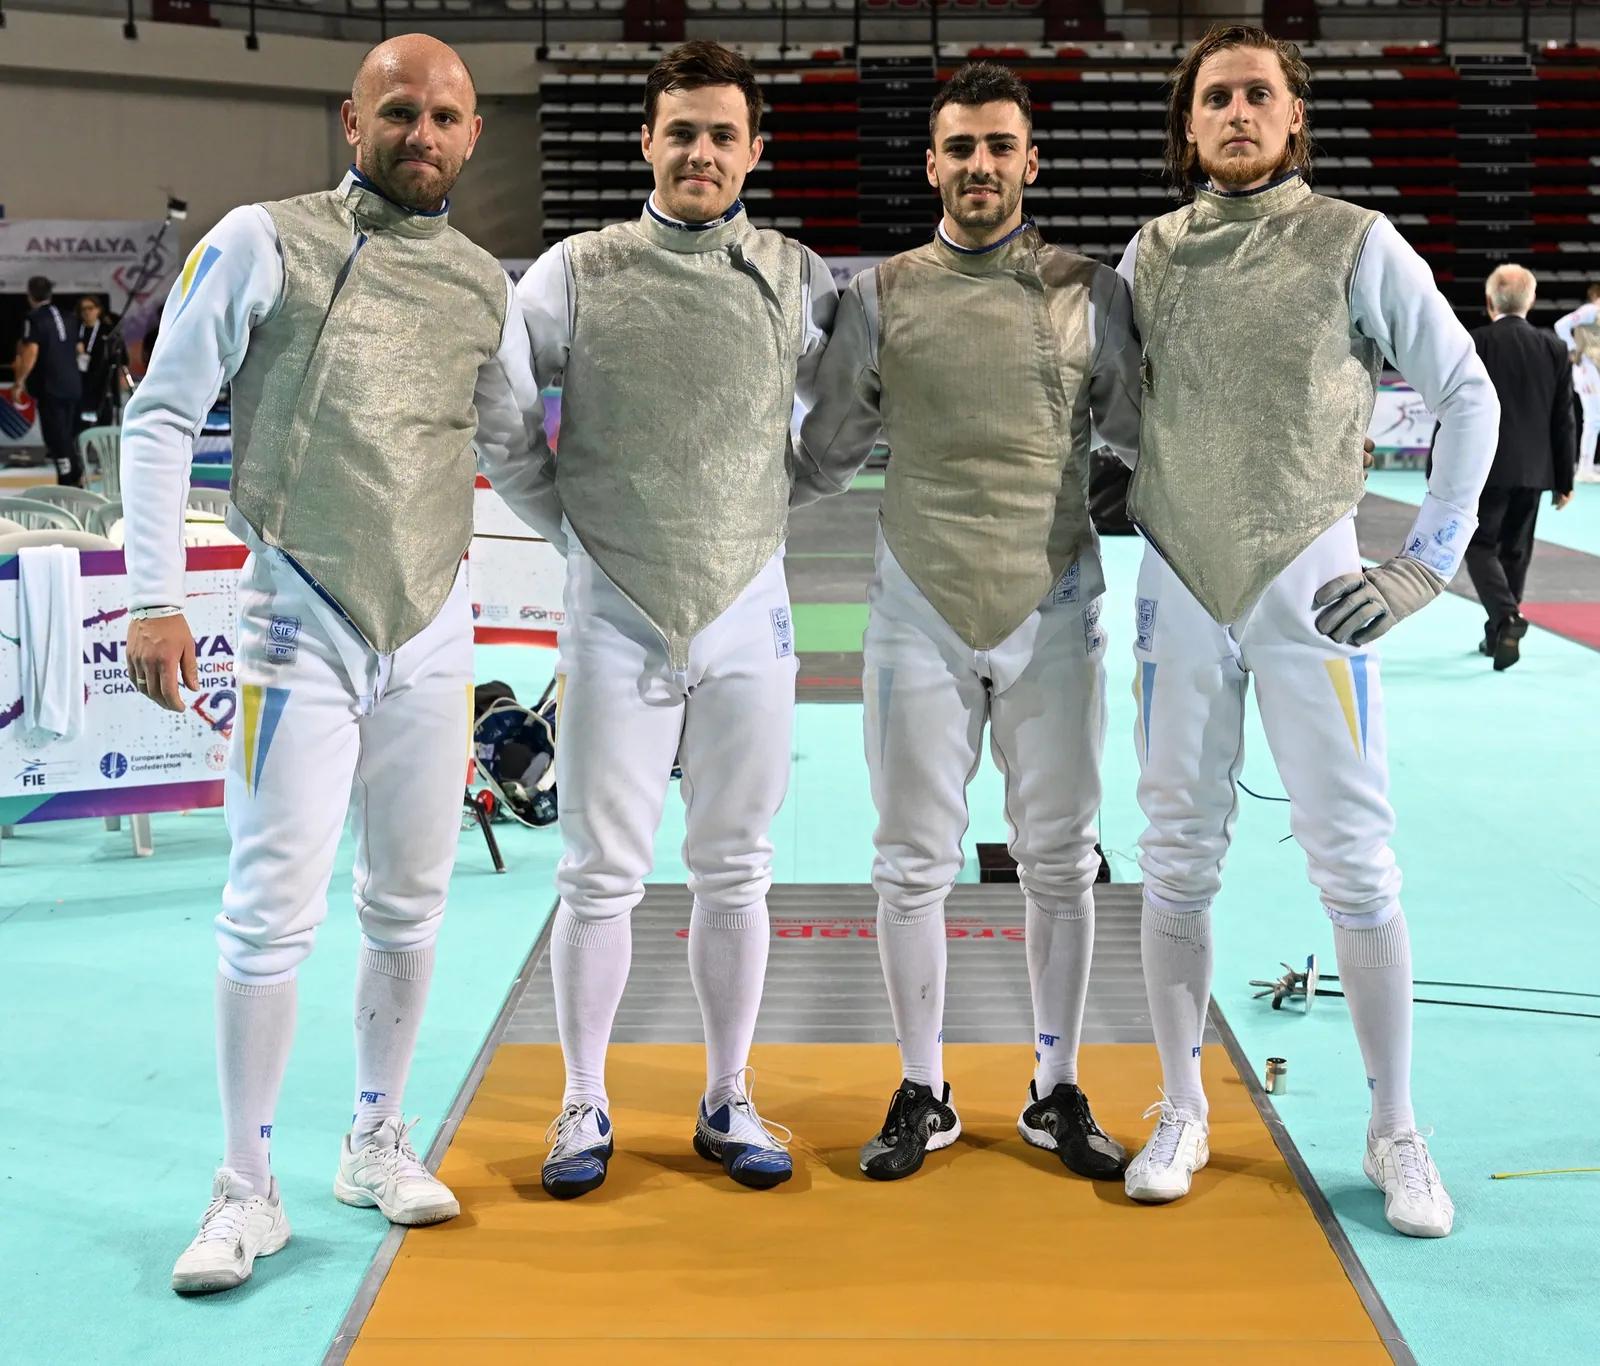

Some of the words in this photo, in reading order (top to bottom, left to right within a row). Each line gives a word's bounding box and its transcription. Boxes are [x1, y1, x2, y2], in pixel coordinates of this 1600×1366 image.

[27, 237, 137, 252] ANTALYA
[166, 751, 193, 760] Fencing
[130, 761, 182, 772] Confederation
[22, 774, 46, 787] FIE
[1039, 1032, 1060, 1047] PBT
[360, 1091, 386, 1104] PBT
